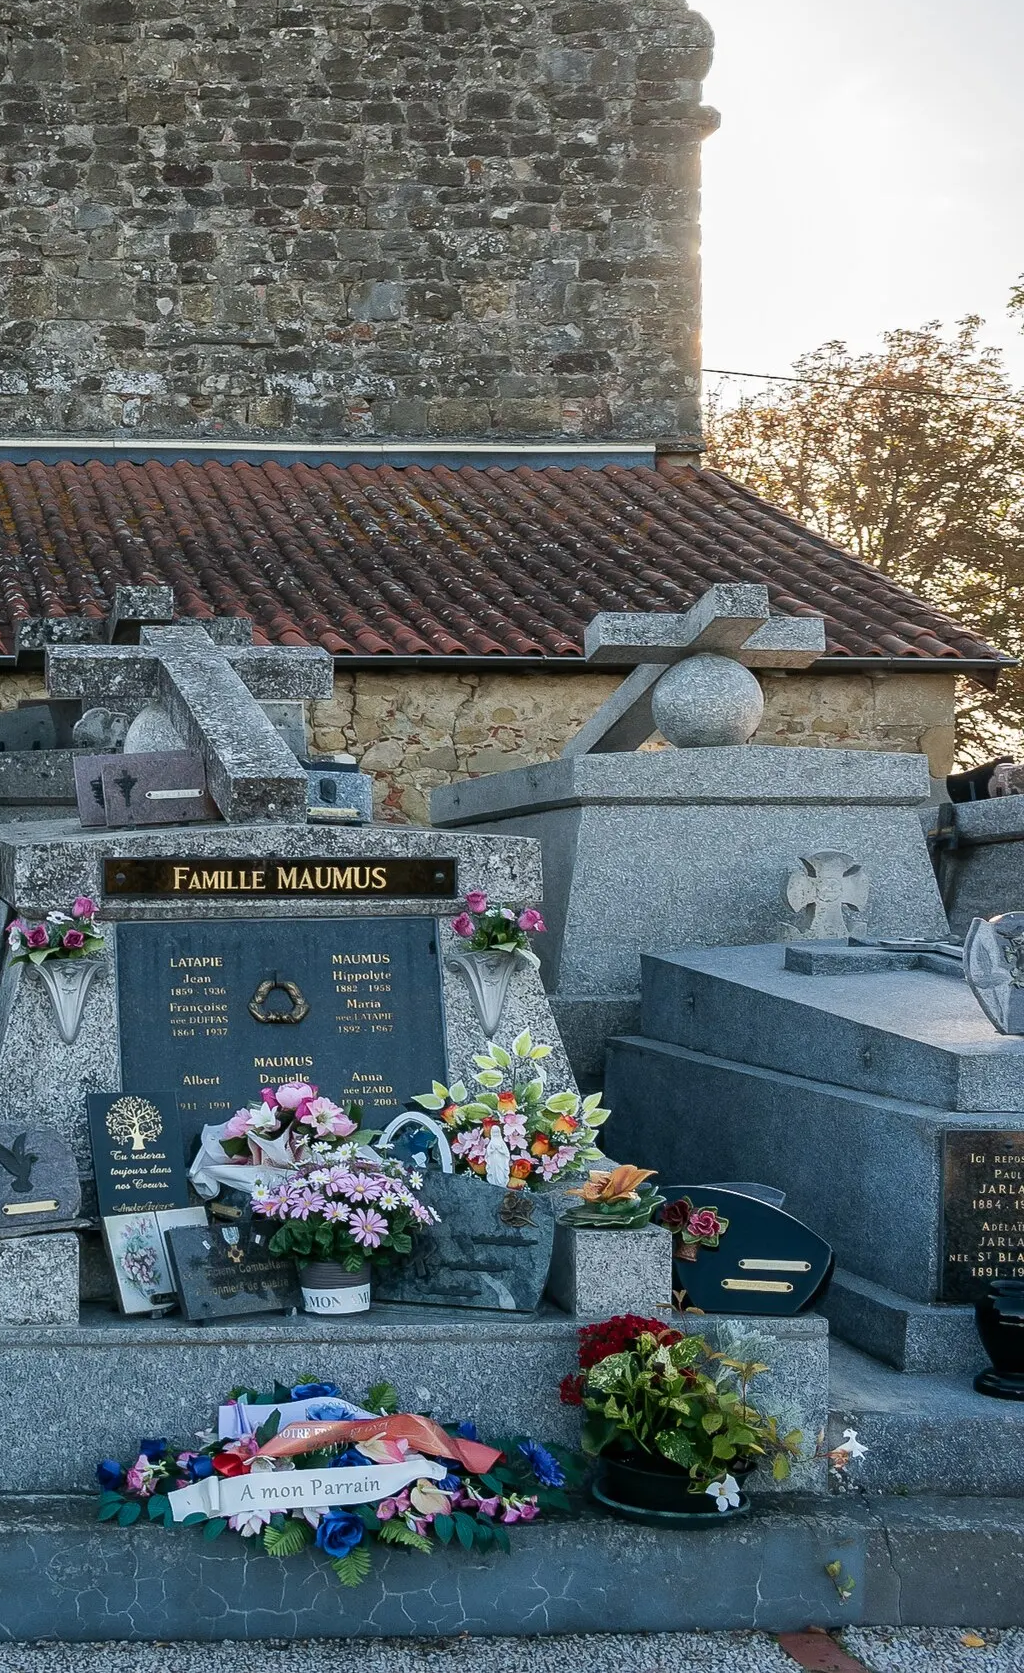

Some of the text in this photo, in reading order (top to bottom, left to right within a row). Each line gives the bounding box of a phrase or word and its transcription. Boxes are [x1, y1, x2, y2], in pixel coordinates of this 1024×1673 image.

[173, 867, 387, 889] FAMILLE MAUMUS
[170, 957, 223, 967] LATAPIE
[332, 954, 391, 964] MAUMUS
[183, 974, 211, 983] Jean
[333, 970, 392, 982] Hippolyte
[170, 988, 193, 996] 1859
[204, 987, 226, 995] 1936
[336, 985, 358, 993] 1882
[369, 984, 391, 992] 1958
[169, 1002, 228, 1013] Françoise
[347, 999, 381, 1009] Maria
[189, 1016, 229, 1024] DUFFAS
[354, 1013, 393, 1021] LATAPIE
[206, 1028, 228, 1036] 1937
[338, 1025, 361, 1033] 1892
[371, 1025, 393, 1033] 1967
[254, 1056, 313, 1067] MAUMUS
[183, 1075, 220, 1085] Albert
[259, 1073, 310, 1084] Danielle
[352, 1071, 383, 1081] Anna
[362, 1085, 393, 1094] IZARD
[209, 1102, 230, 1110] 1991
[373, 1098, 398, 1106] 2003
[110, 1150, 128, 1161] Tu
[110, 1164, 172, 1178] toujours dans
[972, 1199, 1001, 1209] 1884
[972, 1267, 998, 1277] 1891
[309, 1296, 341, 1308] MON
[240, 1476, 381, 1502] A mon Parrain
